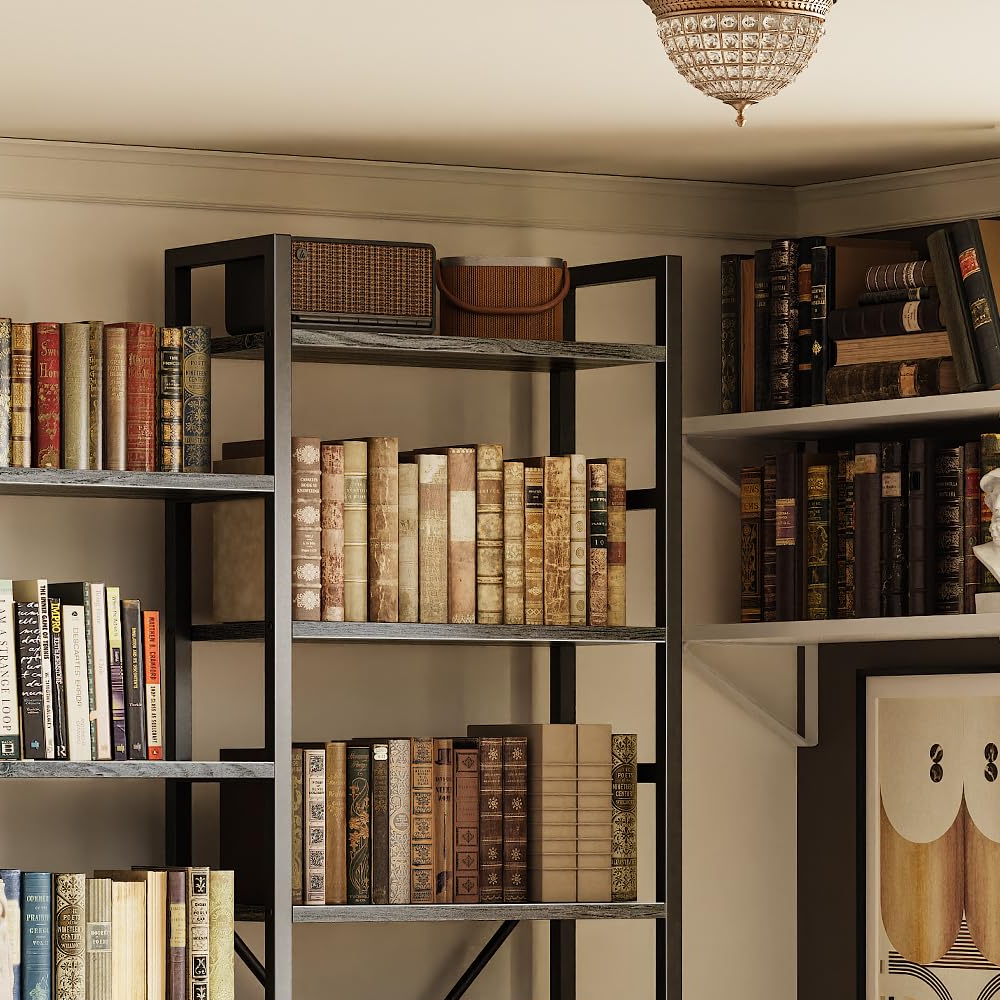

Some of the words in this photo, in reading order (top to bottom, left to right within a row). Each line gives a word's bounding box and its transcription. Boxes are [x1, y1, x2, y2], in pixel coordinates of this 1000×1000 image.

[50, 602, 61, 634] IMPRO
[42, 637, 50, 660] TENNIS
[72, 627, 81, 676] DESCARTES
[0, 640, 10, 695] STRANGE
[1, 698, 12, 732] LOOP
